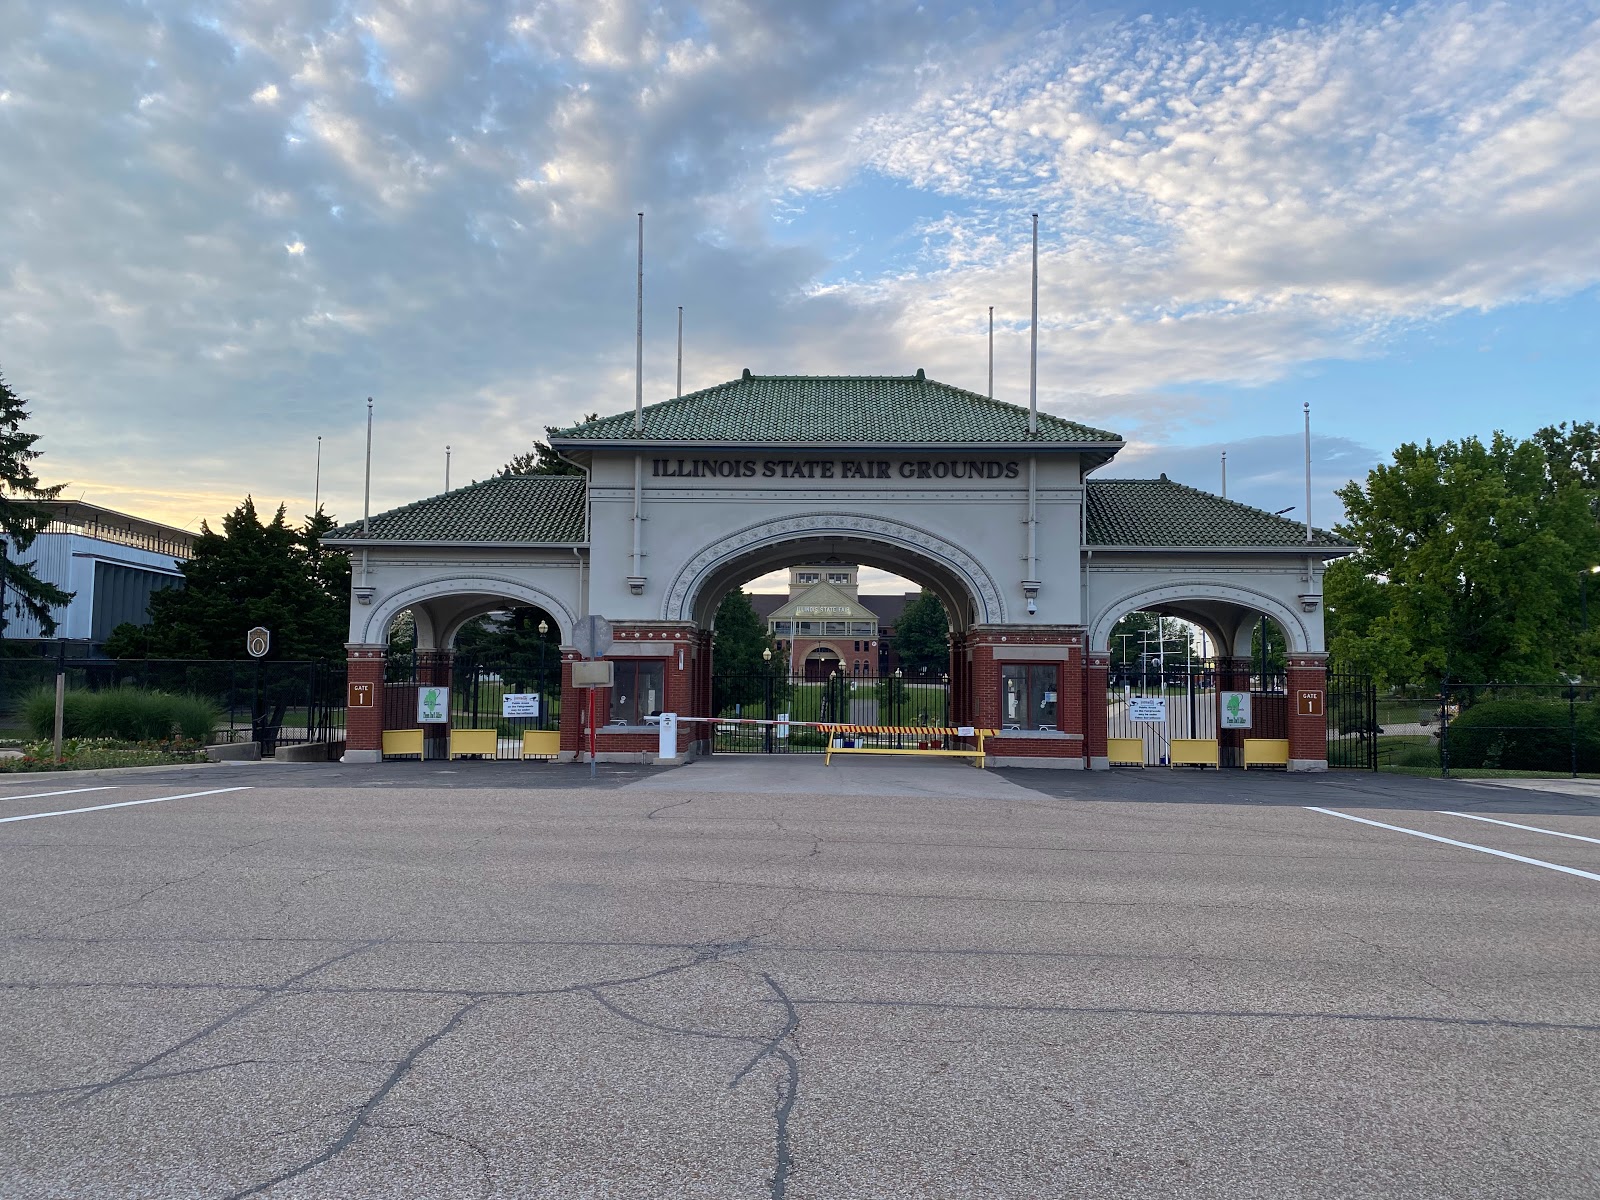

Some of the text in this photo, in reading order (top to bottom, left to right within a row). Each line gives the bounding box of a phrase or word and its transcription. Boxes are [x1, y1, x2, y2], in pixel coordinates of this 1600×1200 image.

[652, 459, 1020, 479] ILLINOIS STATE FAIR GROUNDS
[359, 692, 363, 705] 1
[1308, 700, 1313, 713] 1
